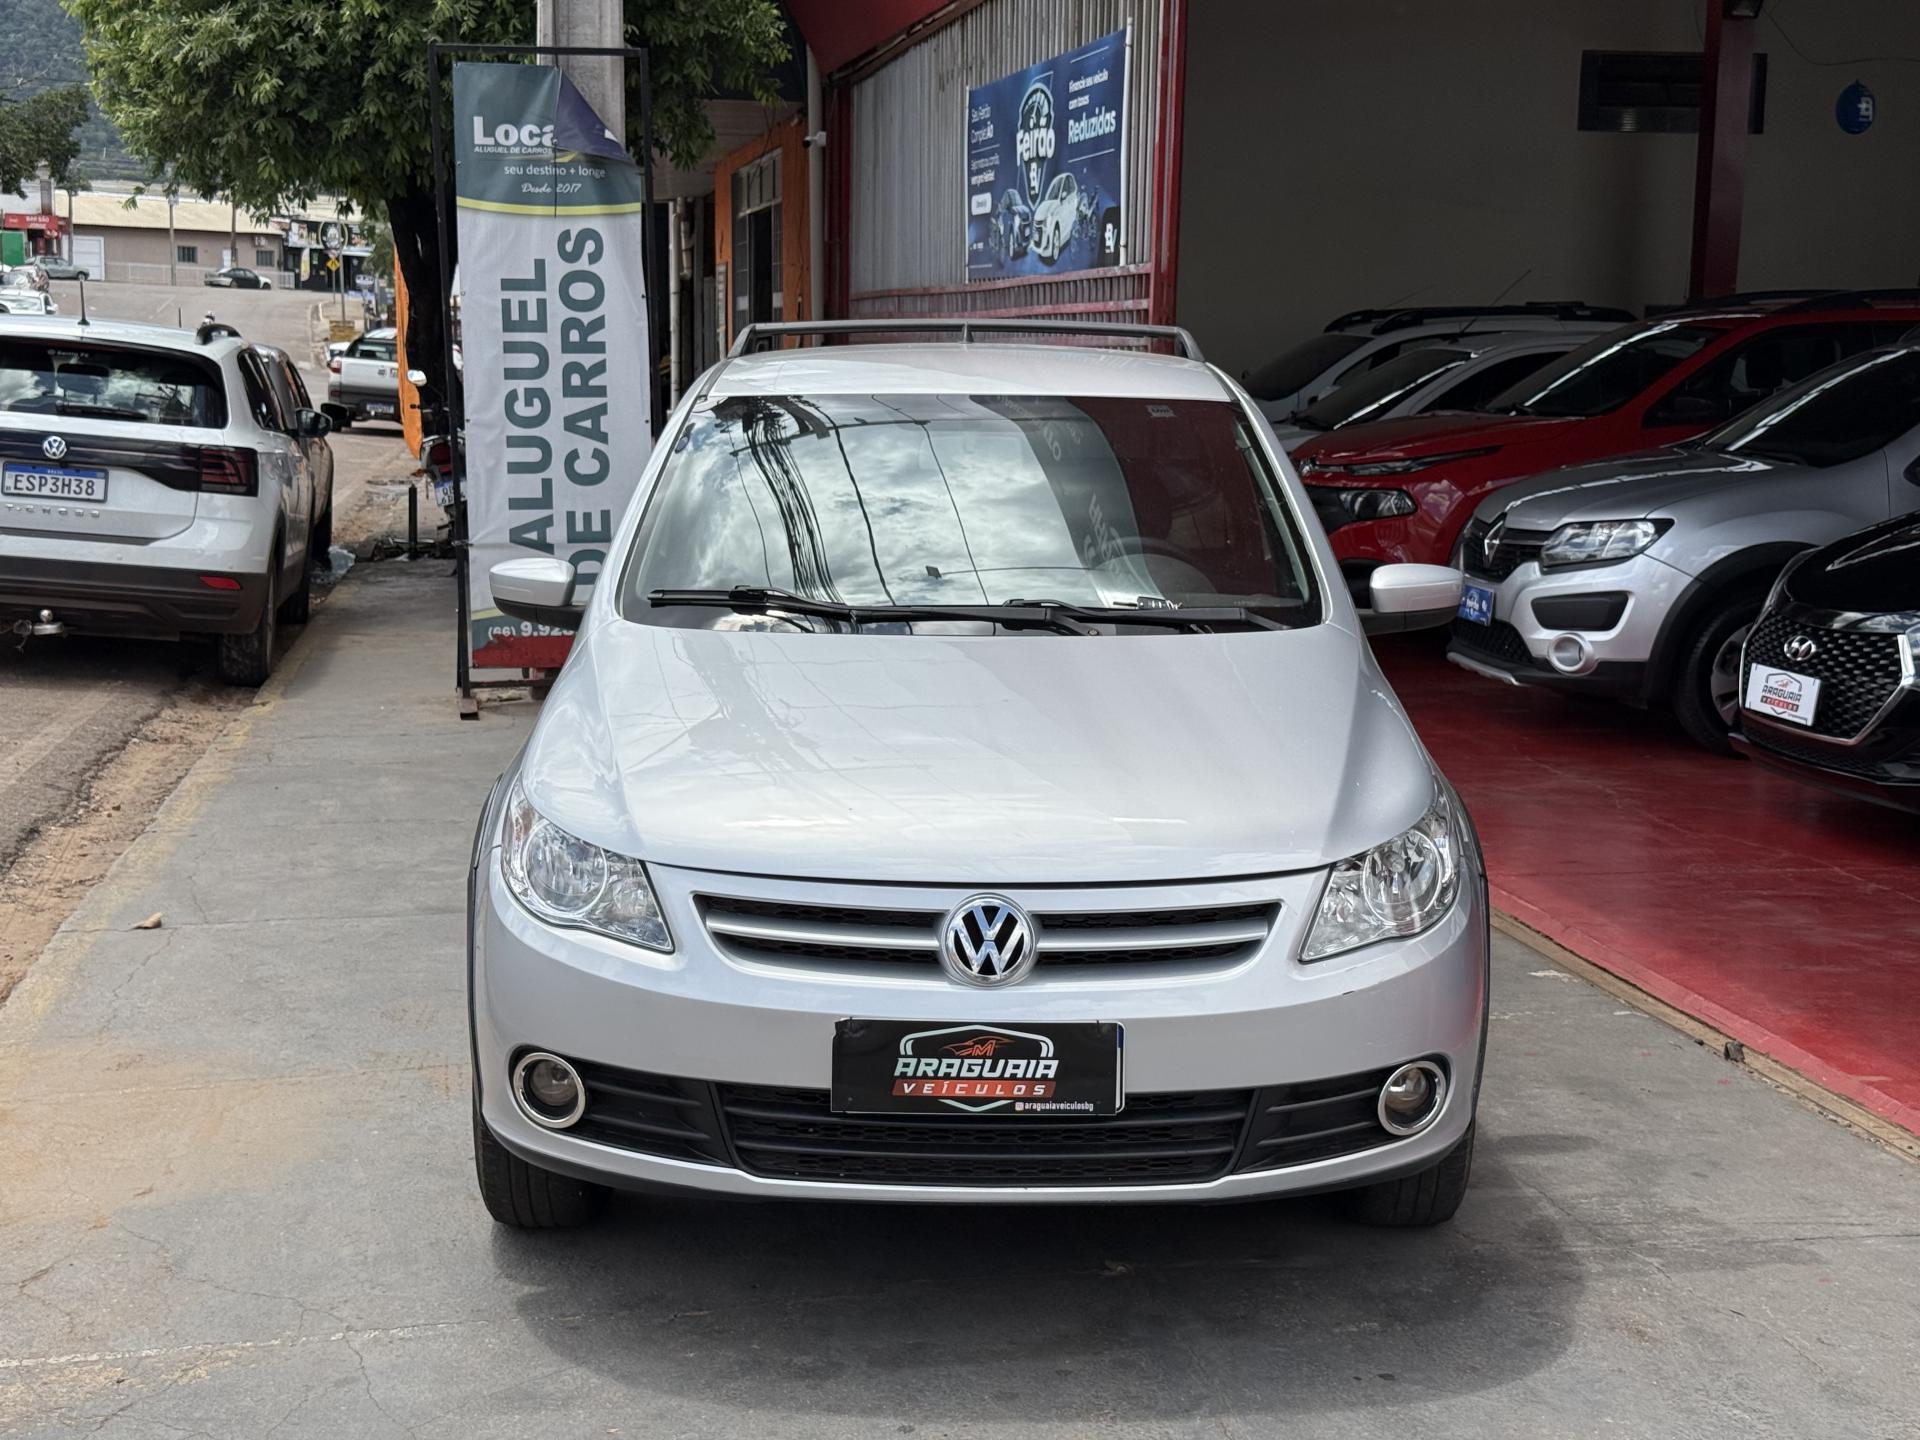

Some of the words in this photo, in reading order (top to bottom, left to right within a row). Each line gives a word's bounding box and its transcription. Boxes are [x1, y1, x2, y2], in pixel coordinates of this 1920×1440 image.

[1068, 106, 1116, 145] Reduzidas
[1016, 116, 1056, 166] Feirão
[504, 166, 524, 175] seu
[526, 164, 567, 175] destino
[578, 165, 606, 179] longe
[521, 183, 552, 193] Desde
[555, 183, 582, 193] 2017
[557, 227, 611, 487] CARROS
[500, 258, 556, 555] ALUGUEL
[13, 474, 95, 496] ESP3H38
[1762, 685, 1803, 703] ARAGUAIA
[893, 1057, 1059, 1079] ARAGUAIA
[903, 1081, 1046, 1095] VEÍCULOS
[1024, 1101, 1094, 1112] araguaiaveiculosbg
